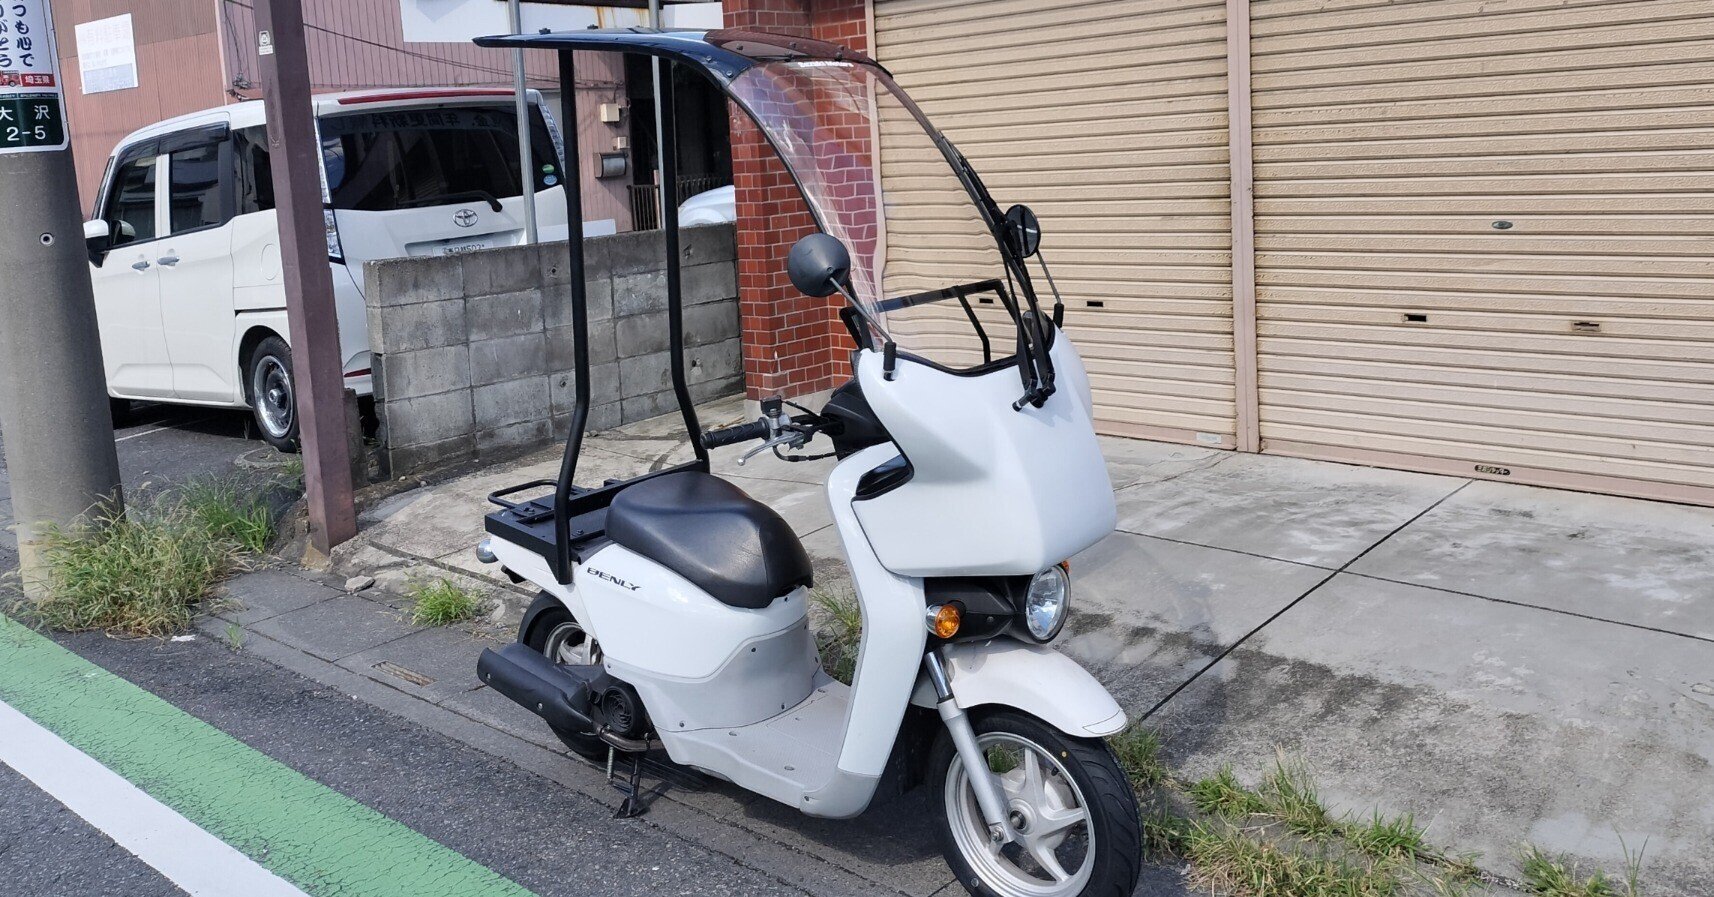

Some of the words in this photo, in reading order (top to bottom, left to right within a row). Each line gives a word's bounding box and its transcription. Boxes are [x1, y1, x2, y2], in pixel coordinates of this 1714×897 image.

[13, 0, 34, 67] つも心で
[25, 75, 50, 84] 埼玉県
[6, 125, 46, 141] 2-5
[587, 567, 642, 591] BENLY
